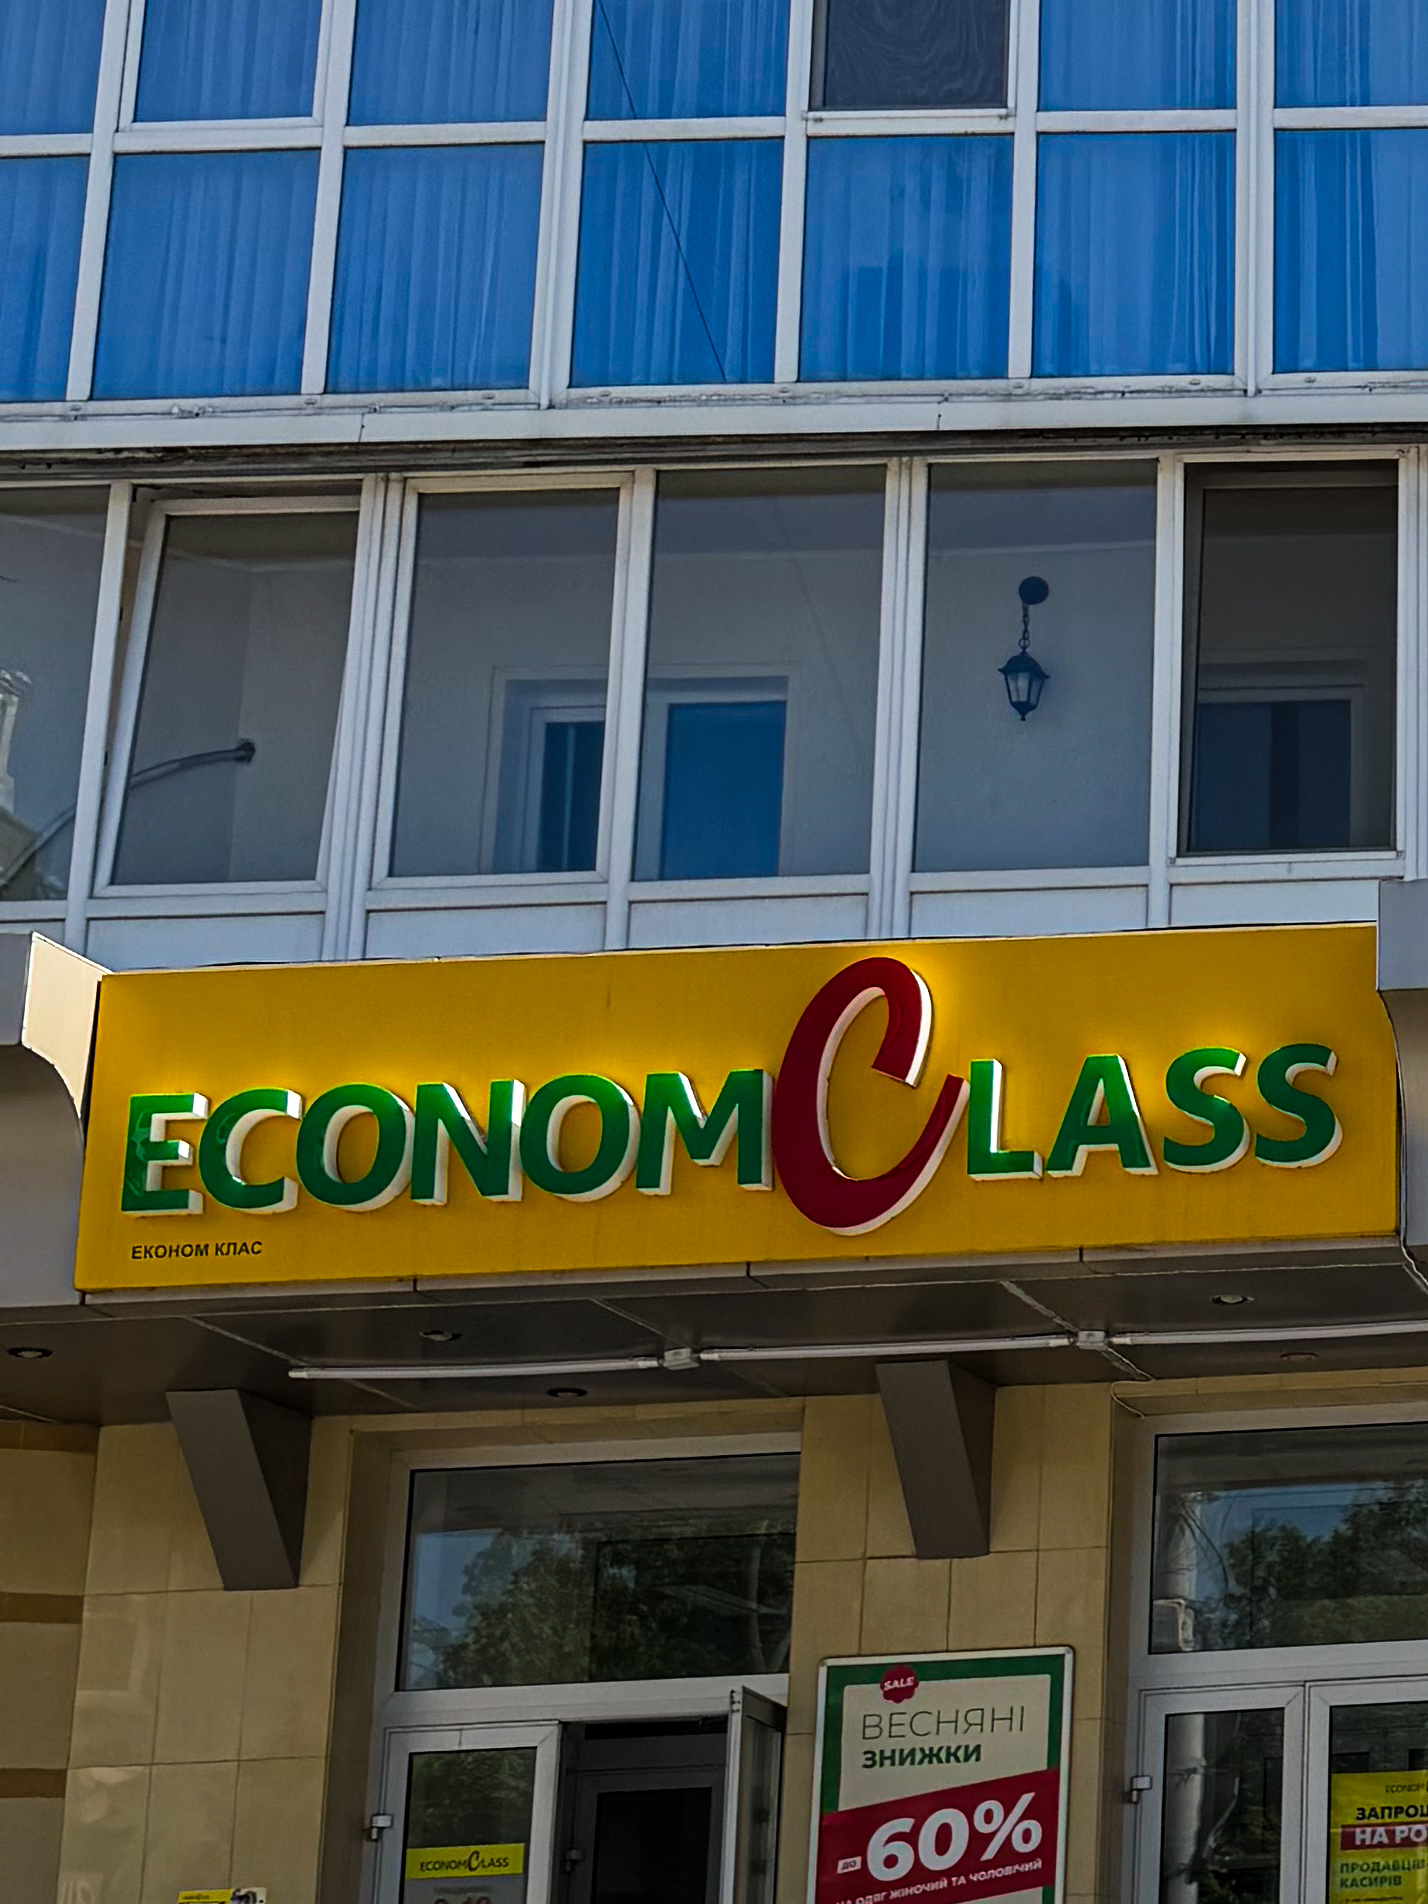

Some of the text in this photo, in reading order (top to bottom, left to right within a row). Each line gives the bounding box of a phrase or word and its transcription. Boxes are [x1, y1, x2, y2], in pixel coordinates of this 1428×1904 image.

[131, 1240, 263, 1260] ЕКОНОМ КЛАС
[883, 1675, 915, 1692] SALE
[861, 1705, 1025, 1741] ВЕСНЯНІ
[861, 1743, 982, 1770] ЗНИЖКИ
[1354, 1827, 1390, 1846] НА
[951, 1875, 967, 1887] ТА
[1339, 1875, 1403, 1889] КАСИРІВ
